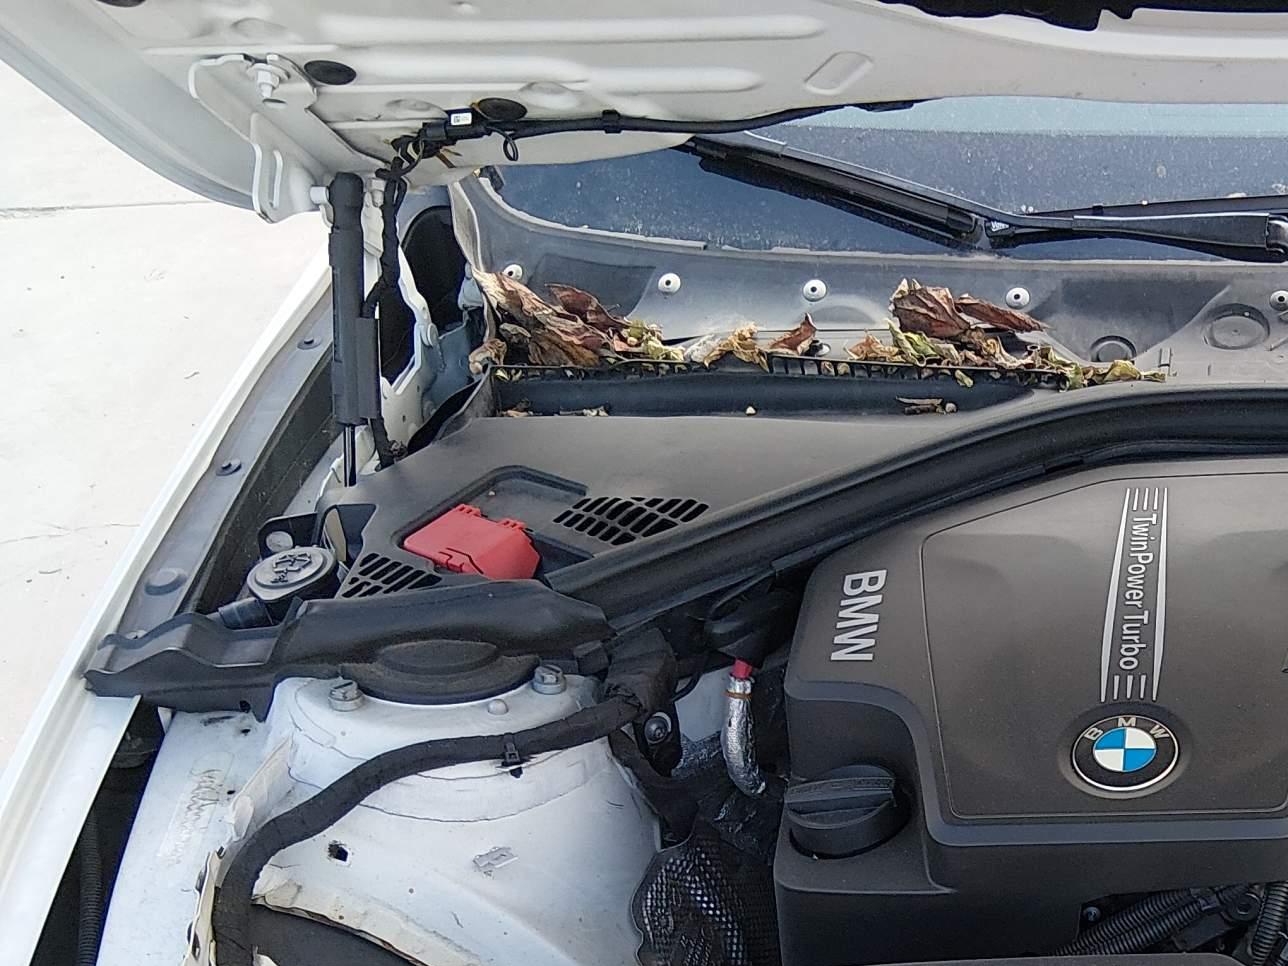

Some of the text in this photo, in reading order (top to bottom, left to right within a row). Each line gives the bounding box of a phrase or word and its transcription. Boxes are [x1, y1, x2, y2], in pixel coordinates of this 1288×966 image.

[830, 568, 888, 662] BMW
[1119, 513, 1157, 670] TwinPower Turbo
[1084, 716, 1170, 741] BMW
